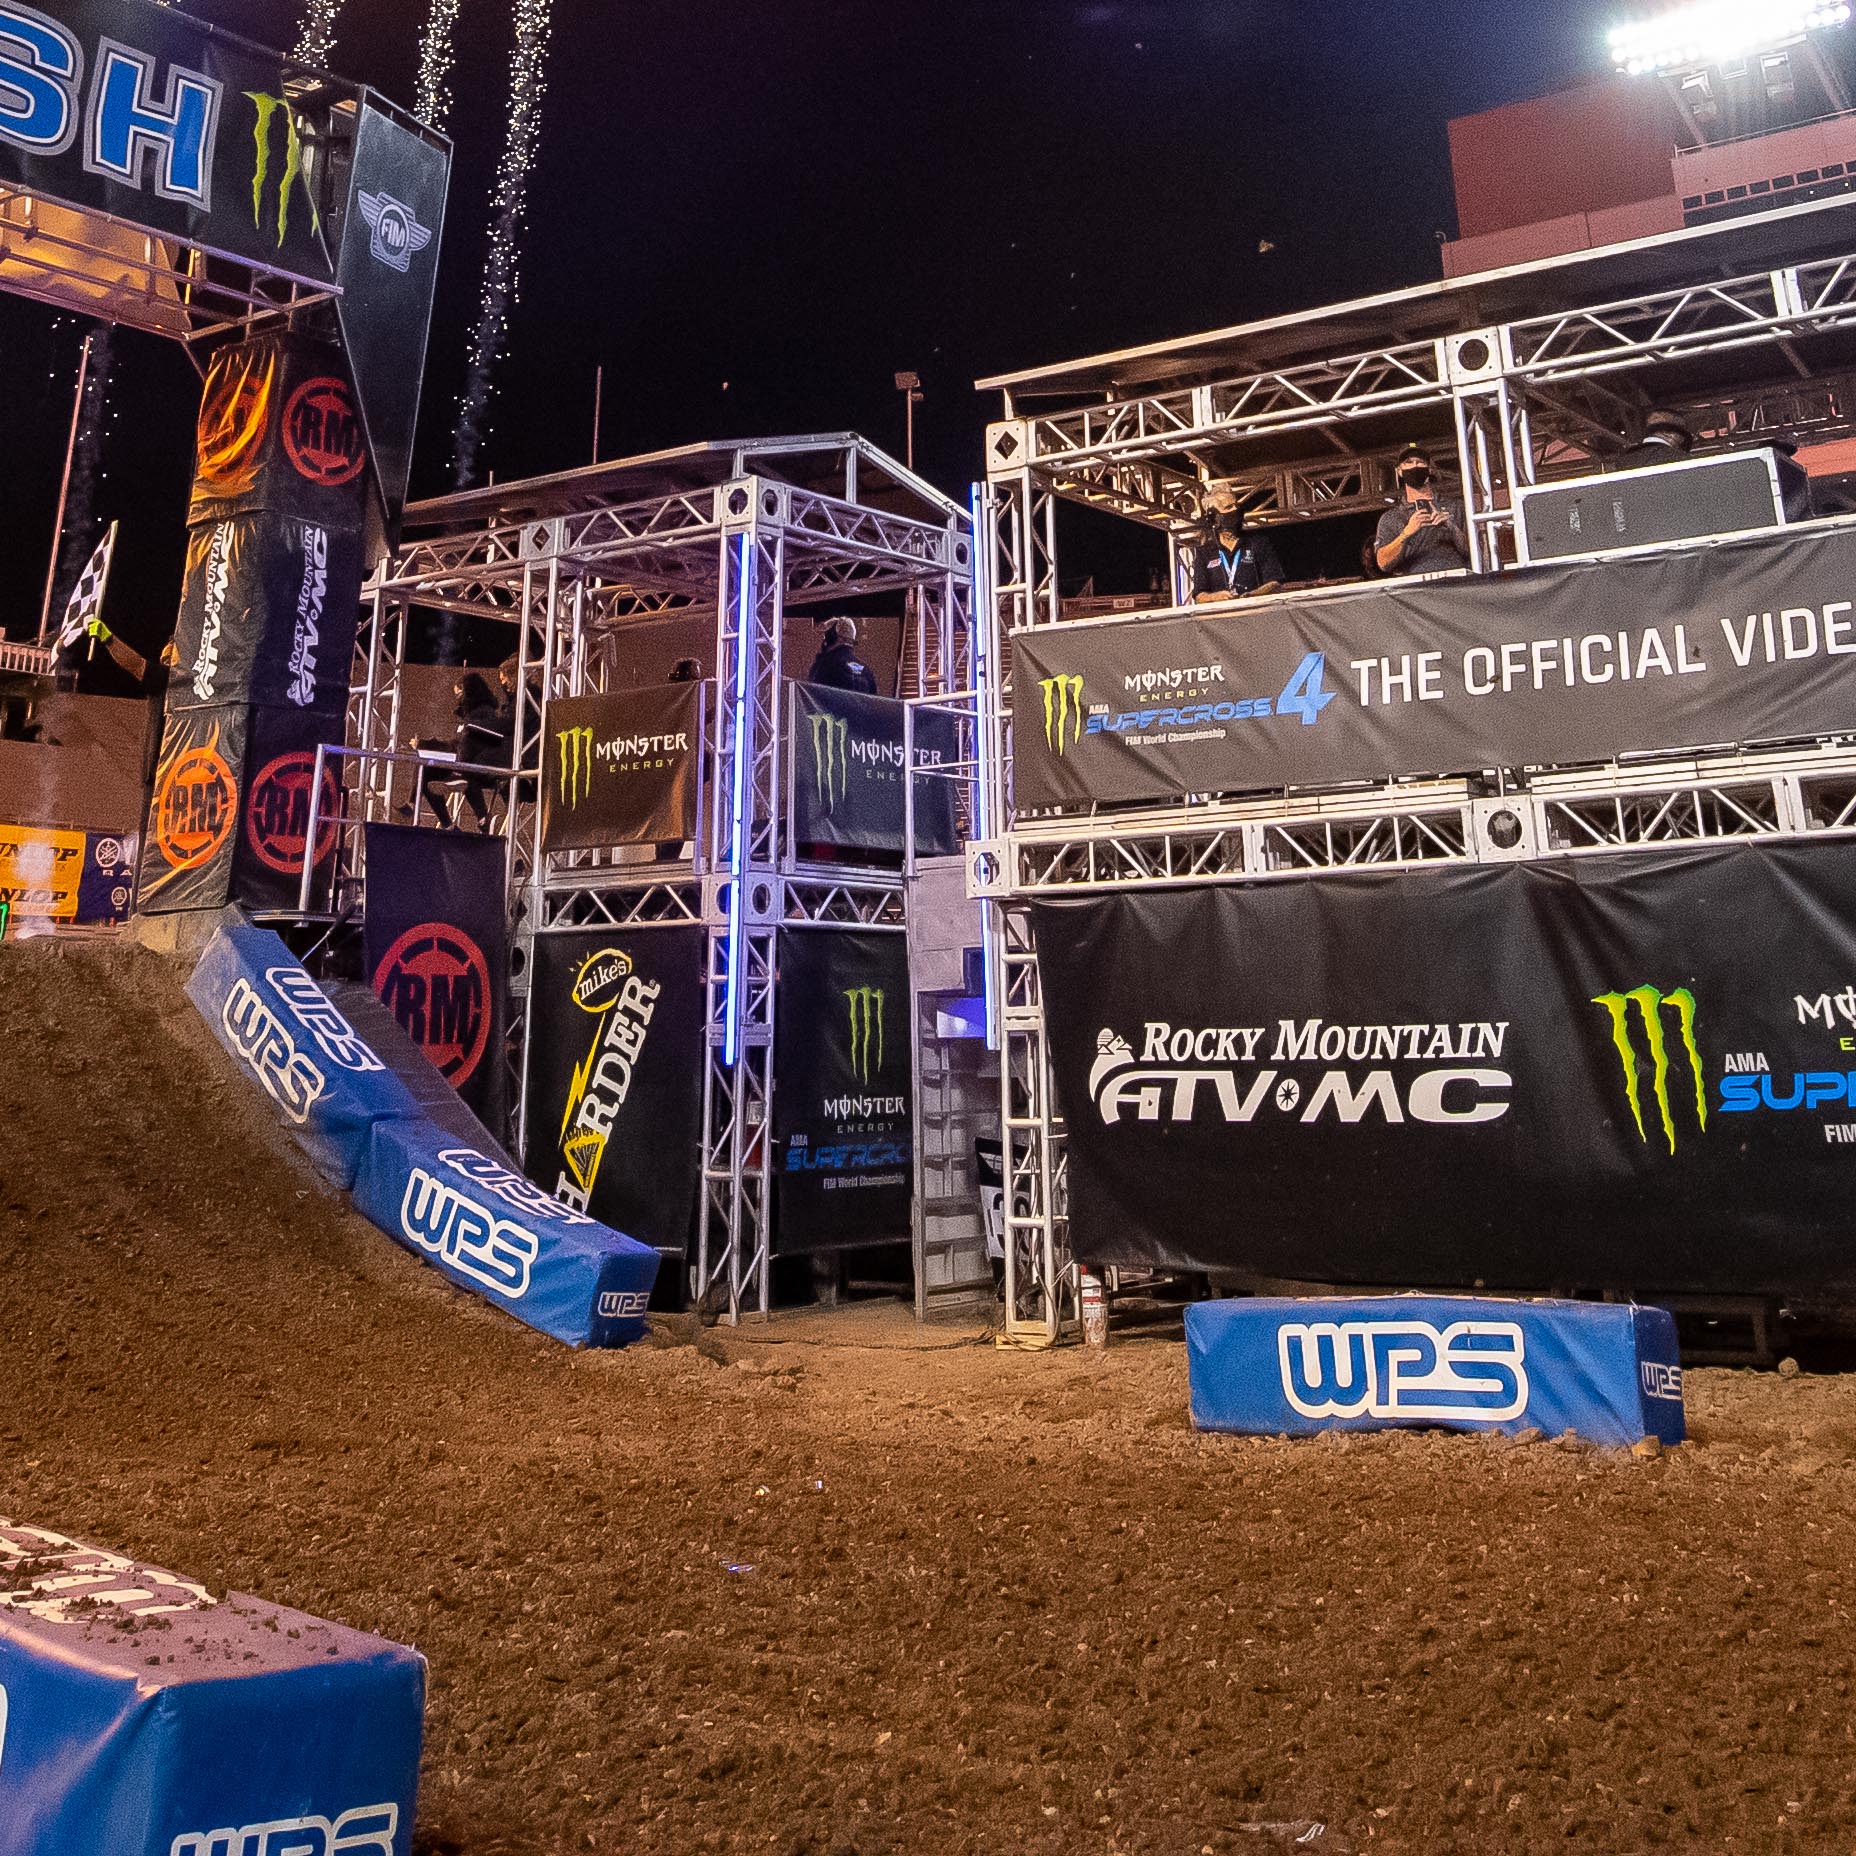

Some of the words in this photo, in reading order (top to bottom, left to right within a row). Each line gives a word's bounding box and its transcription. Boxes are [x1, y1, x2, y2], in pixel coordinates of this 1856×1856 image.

[1124, 664, 1225, 693] MONSTER
[1350, 651, 1444, 707] THE
[1463, 624, 1706, 696] OFFICIAL
[1086, 696, 1273, 736] SUPERCROSS
[1276, 651, 1337, 726] 4
[1140, 687, 1210, 703] ENERGY
[595, 732, 688, 761] MONSTER
[609, 758, 675, 773] ENERGY
[578, 959, 628, 1000] mike's
[1140, 1021, 1265, 1062] ROCKY
[1271, 1019, 1509, 1060] MOUNTAIN
[1724, 1053, 1770, 1074] AMA
[824, 1094, 905, 1120] MONSTER
[837, 1123, 894, 1134] ENERGY
[400, 1167, 539, 1299] WPS
[1277, 1320, 1530, 1422] WPS
